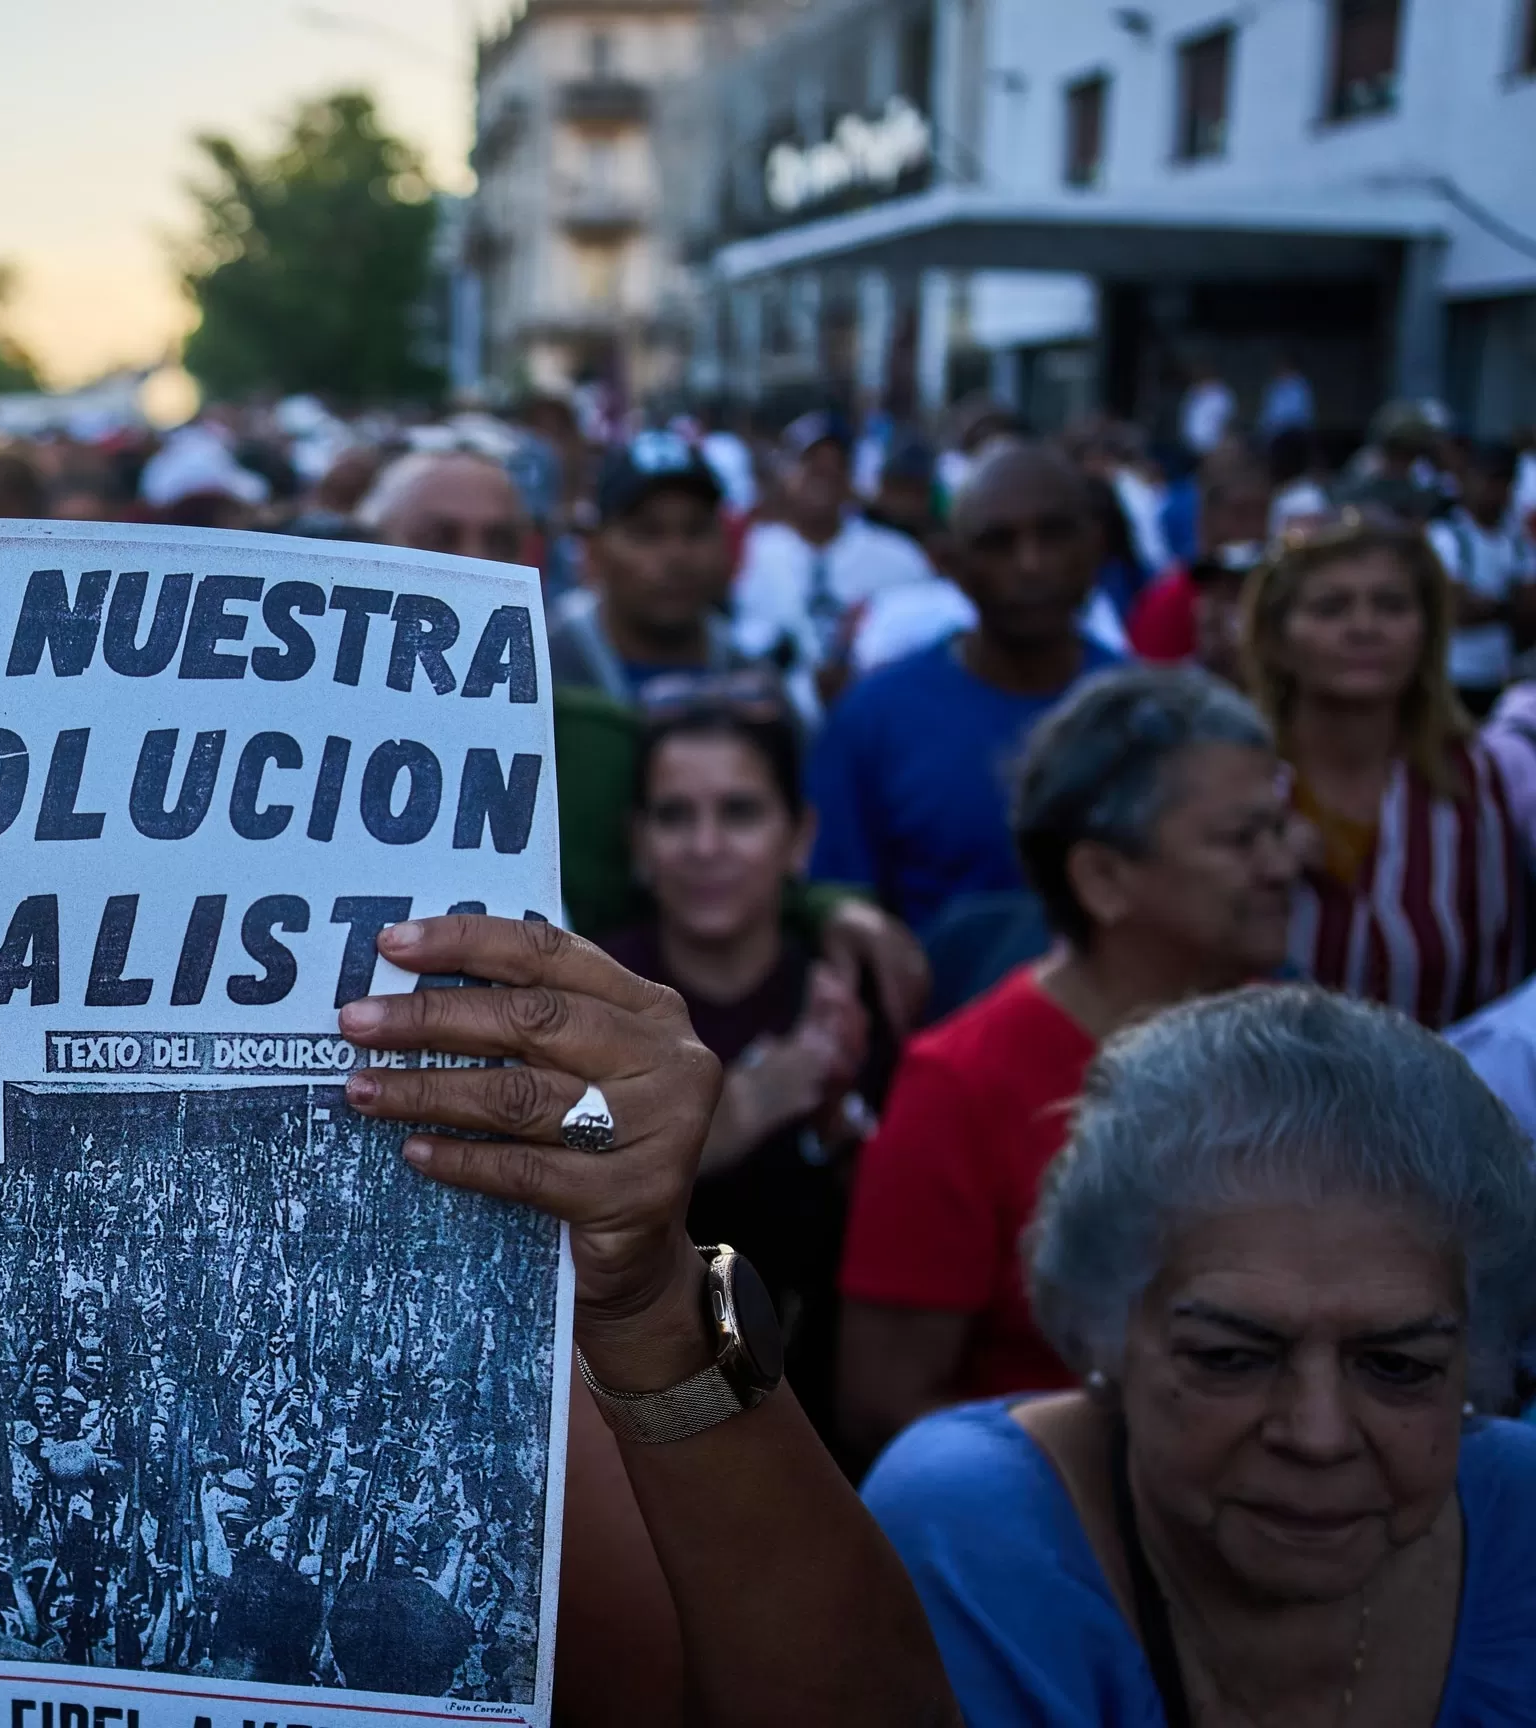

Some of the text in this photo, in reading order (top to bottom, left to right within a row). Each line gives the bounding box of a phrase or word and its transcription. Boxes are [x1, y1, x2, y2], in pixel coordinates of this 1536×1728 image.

[5, 569, 539, 704] NUESTRA
[52, 1036, 141, 1069] TEXTO
[152, 1037, 202, 1068] DEL
[213, 1039, 356, 1071] DISCURSO
